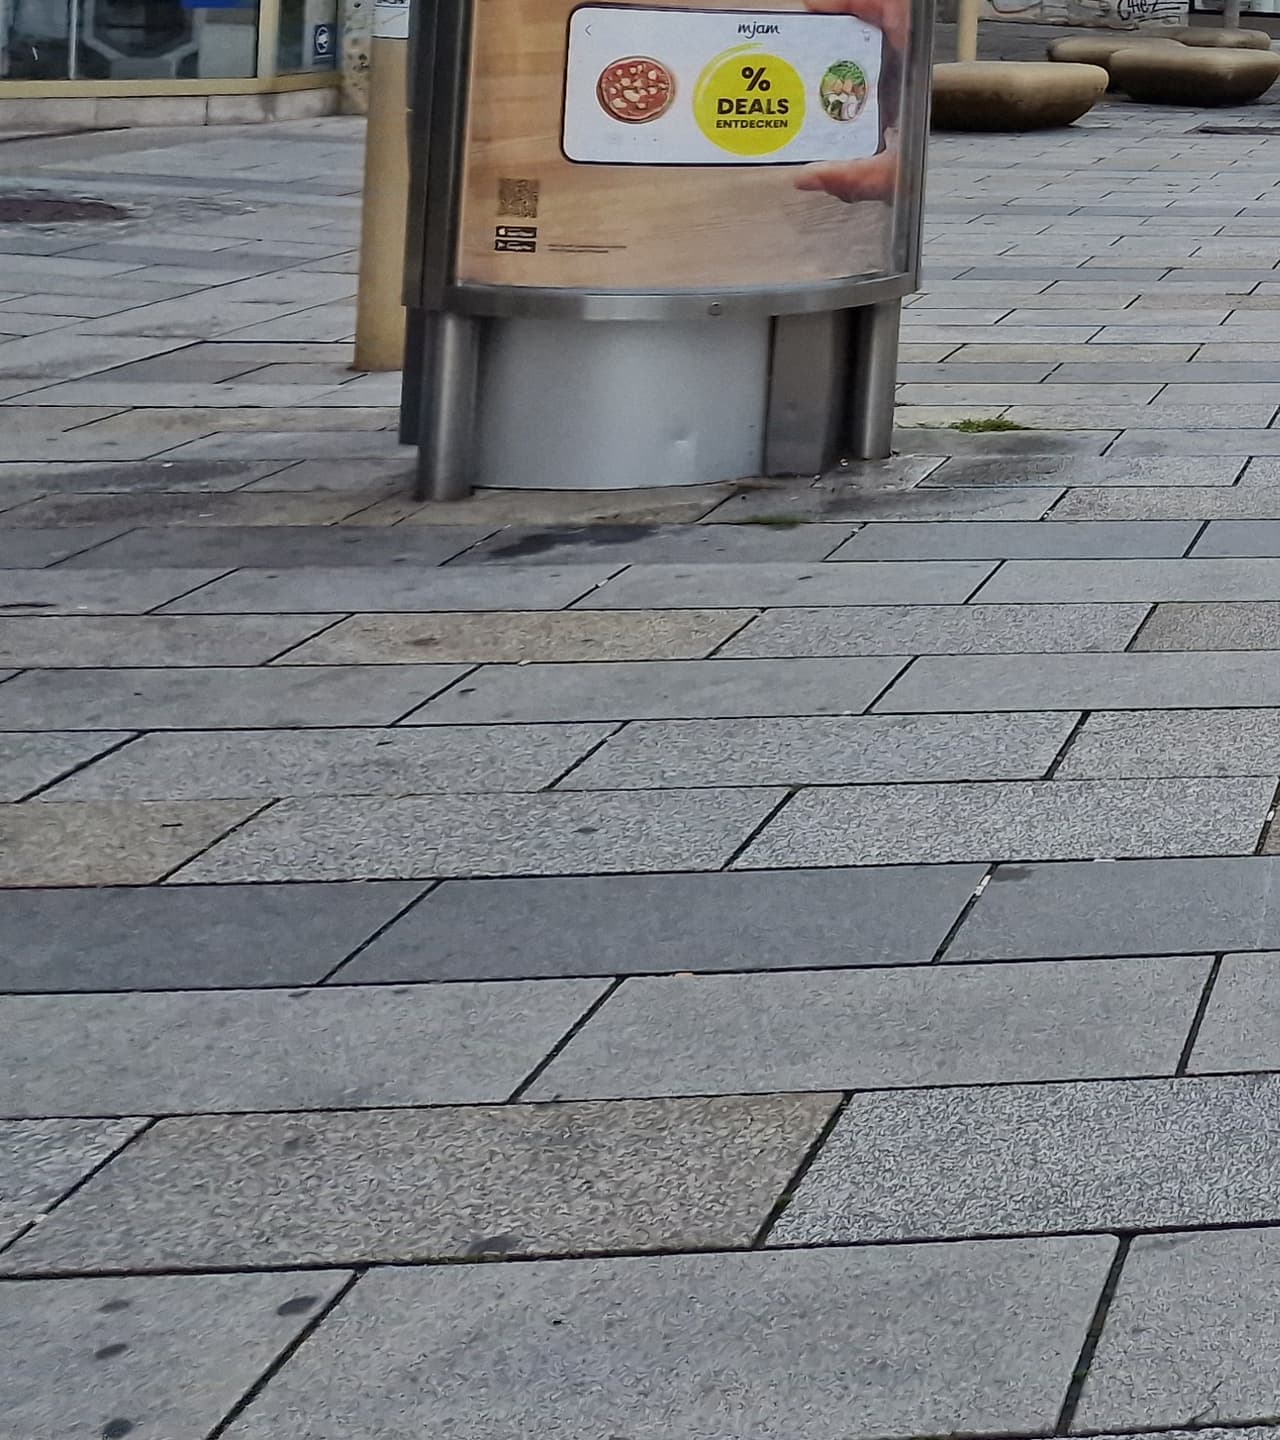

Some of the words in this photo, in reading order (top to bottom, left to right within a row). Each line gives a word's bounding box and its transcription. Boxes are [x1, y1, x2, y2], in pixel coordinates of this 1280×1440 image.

[737, 20, 781, 39] mjam
[741, 66, 771, 93] %
[716, 97, 789, 116] DEALS
[716, 118, 788, 131] ENTDECKEN
